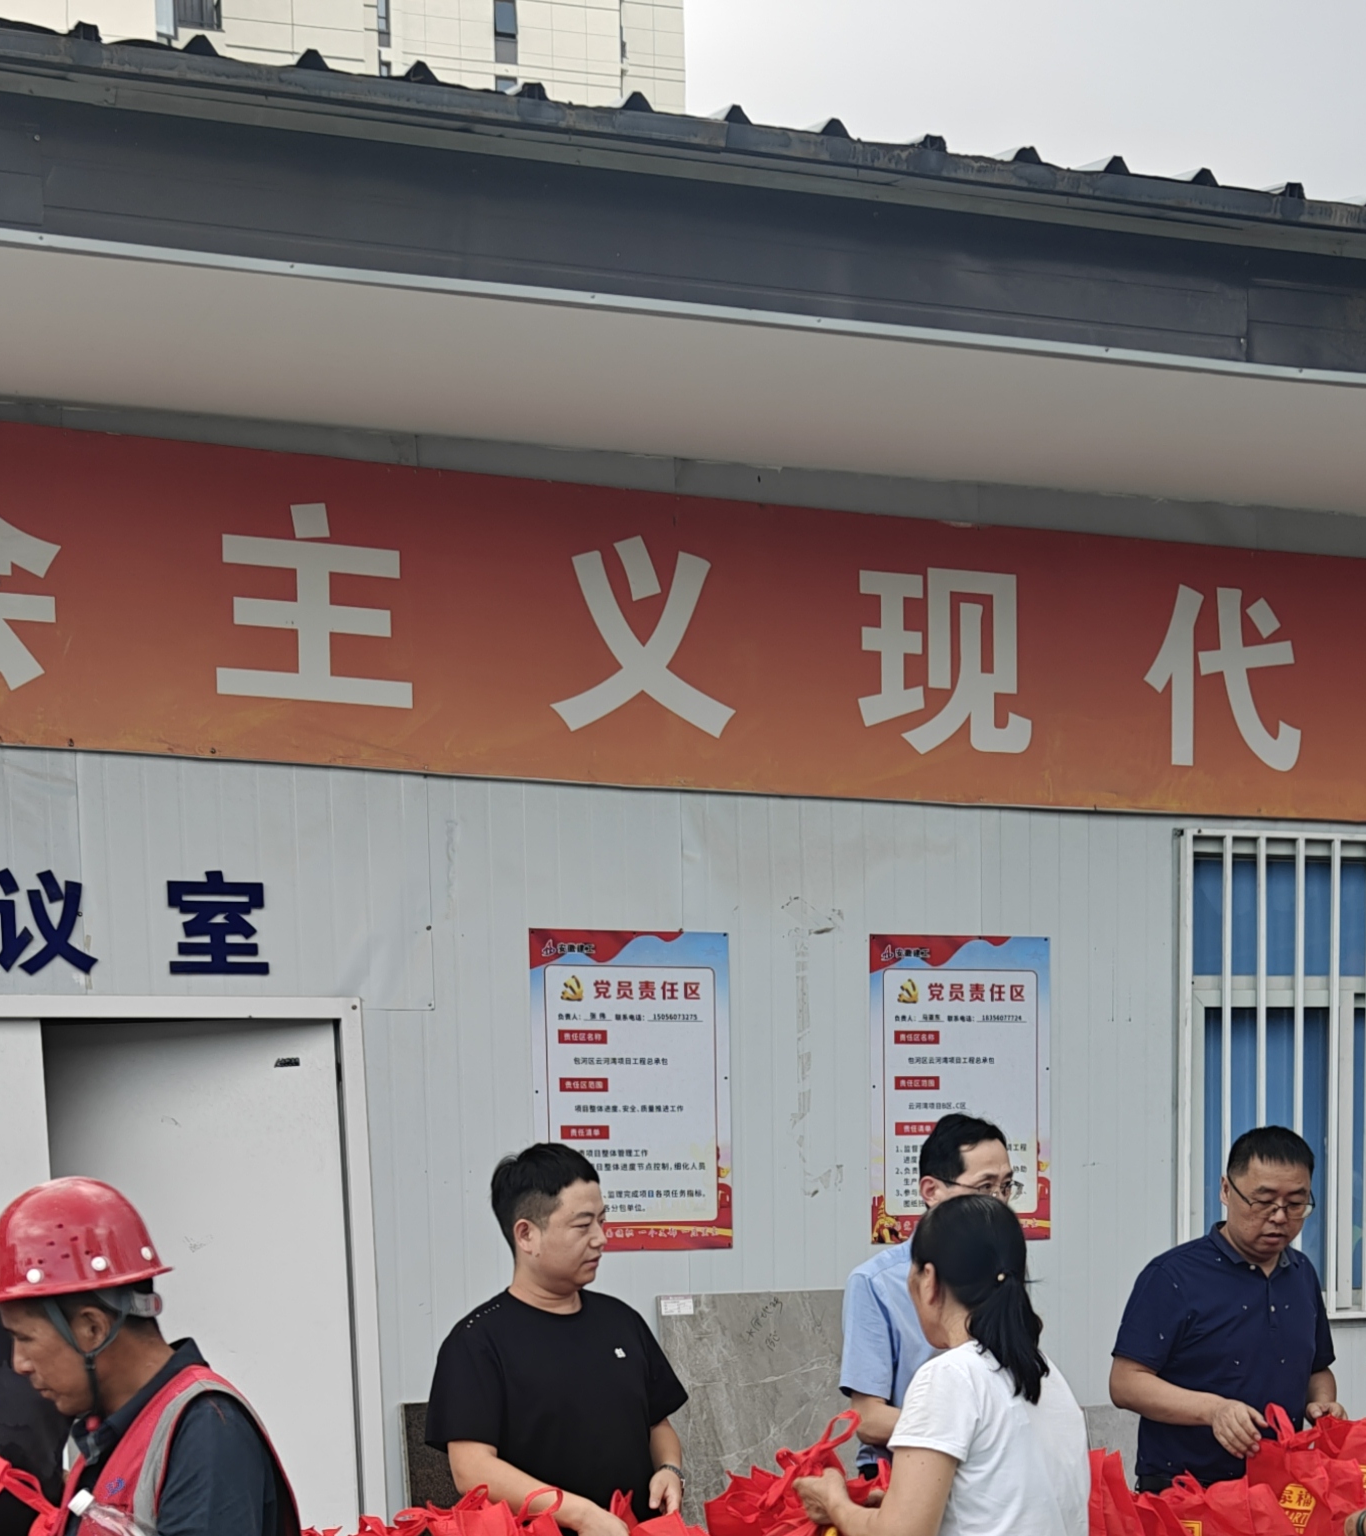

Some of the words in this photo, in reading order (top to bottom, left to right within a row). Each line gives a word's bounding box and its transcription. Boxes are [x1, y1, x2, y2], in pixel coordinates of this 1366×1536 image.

[593, 979, 701, 1000] 党员责任区
[928, 983, 1025, 1002] 党员责任区
[564, 1033, 602, 1041] 责任区名称
[900, 1033, 935, 1042] 责任区名称
[573, 1057, 669, 1065] 包河区云河湾项目工程总承包
[908, 1057, 995, 1065] 包河区云河湾项目工程总承包
[565, 1080, 603, 1089] 责任区范围
[900, 1079, 935, 1087] 责任区范围
